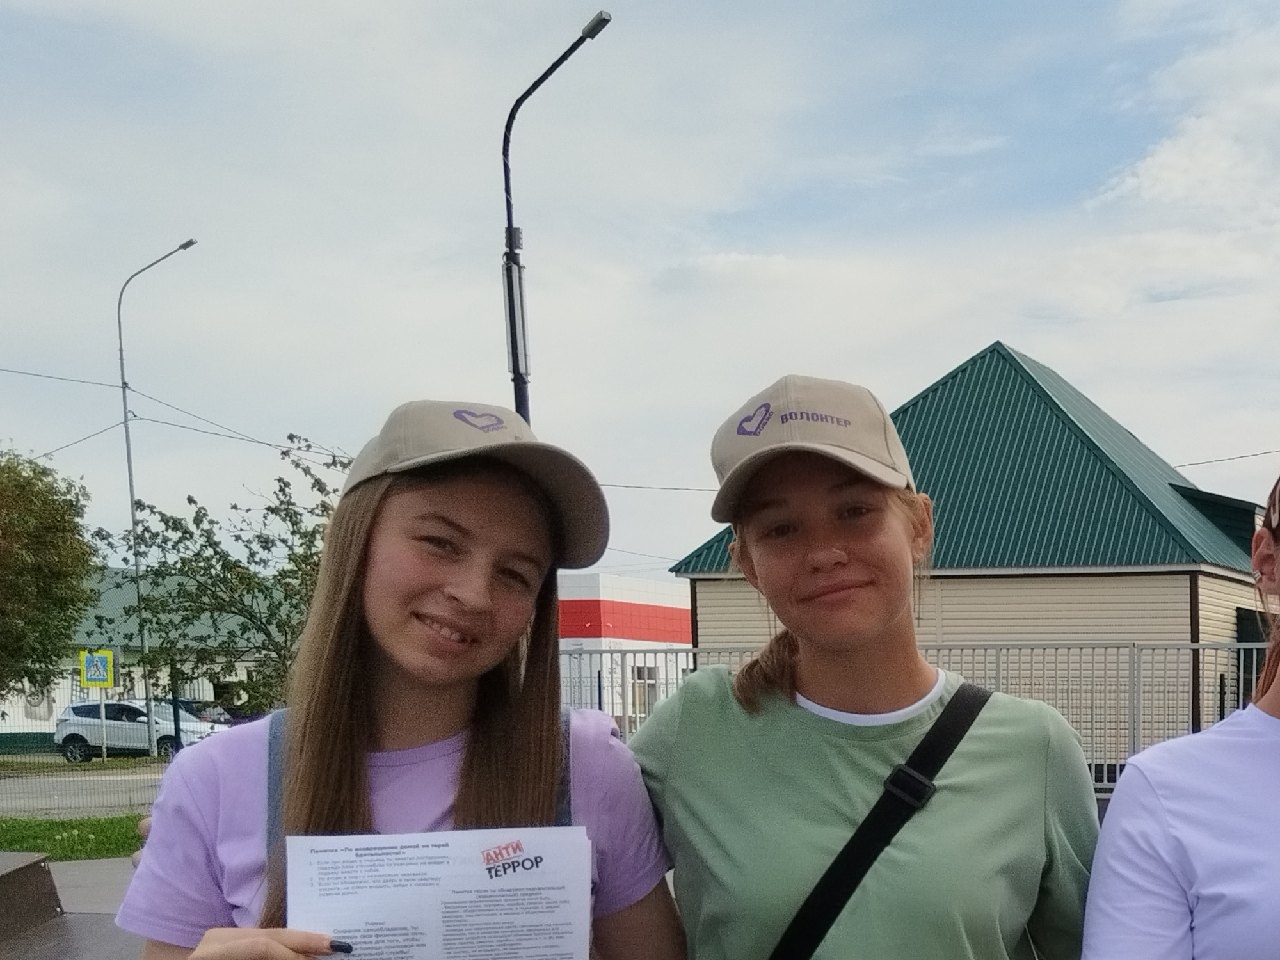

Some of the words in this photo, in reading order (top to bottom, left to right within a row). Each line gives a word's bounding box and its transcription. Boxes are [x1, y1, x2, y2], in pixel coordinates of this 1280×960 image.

[780, 411, 852, 428] ВОЛОНТЕР
[485, 841, 523, 865] АНТИ
[485, 855, 544, 879] ТЕРРОР
